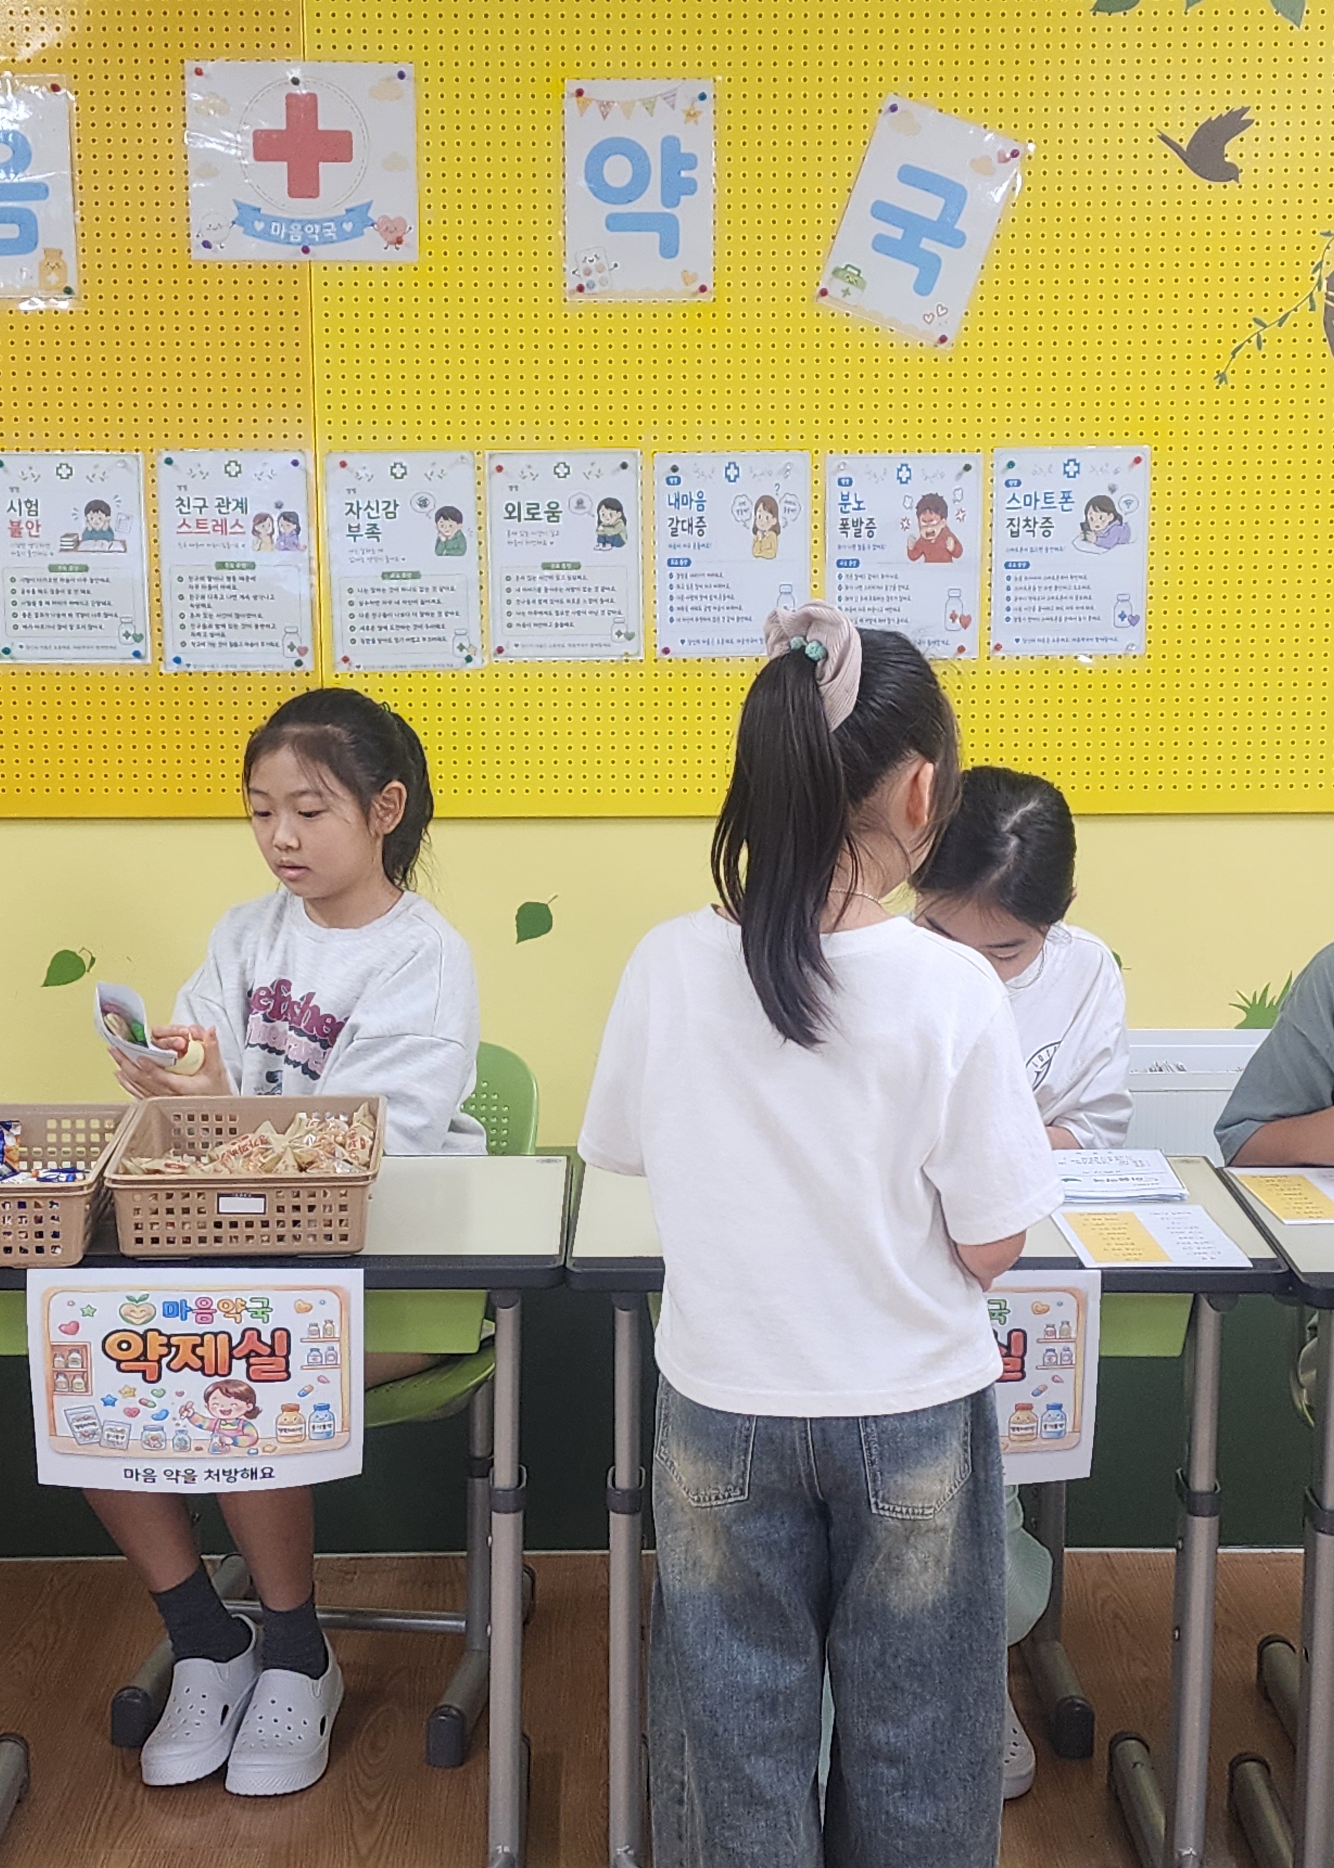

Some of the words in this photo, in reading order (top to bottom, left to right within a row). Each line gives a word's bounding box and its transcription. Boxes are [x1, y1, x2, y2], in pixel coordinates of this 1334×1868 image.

[583, 134, 699, 260] 약
[270, 221, 338, 242] 마음약국
[869, 162, 969, 297] 국
[7, 498, 39, 517] 시험
[175, 496, 210, 515] 친구
[214, 496, 249, 515] 관계
[344, 499, 399, 519] 자신감
[668, 490, 706, 512] 내마음
[838, 492, 866, 514] 분노
[1005, 490, 1075, 512] 스마트폰
[503, 501, 563, 523] 외로움
[8, 519, 41, 538] 불안
[176, 518, 246, 536] 스트레스
[346, 523, 382, 543] 부족
[668, 516, 707, 537] 갈대증
[839, 517, 877, 538] 폭발증
[1006, 516, 1055, 538] 집착증
[162, 1296, 274, 1324] 마음약국
[101, 1327, 292, 1383] 약제실
[122, 1467, 158, 1484] 마음
[163, 1467, 198, 1485] 약을
[203, 1466, 276, 1485] 처방해요
